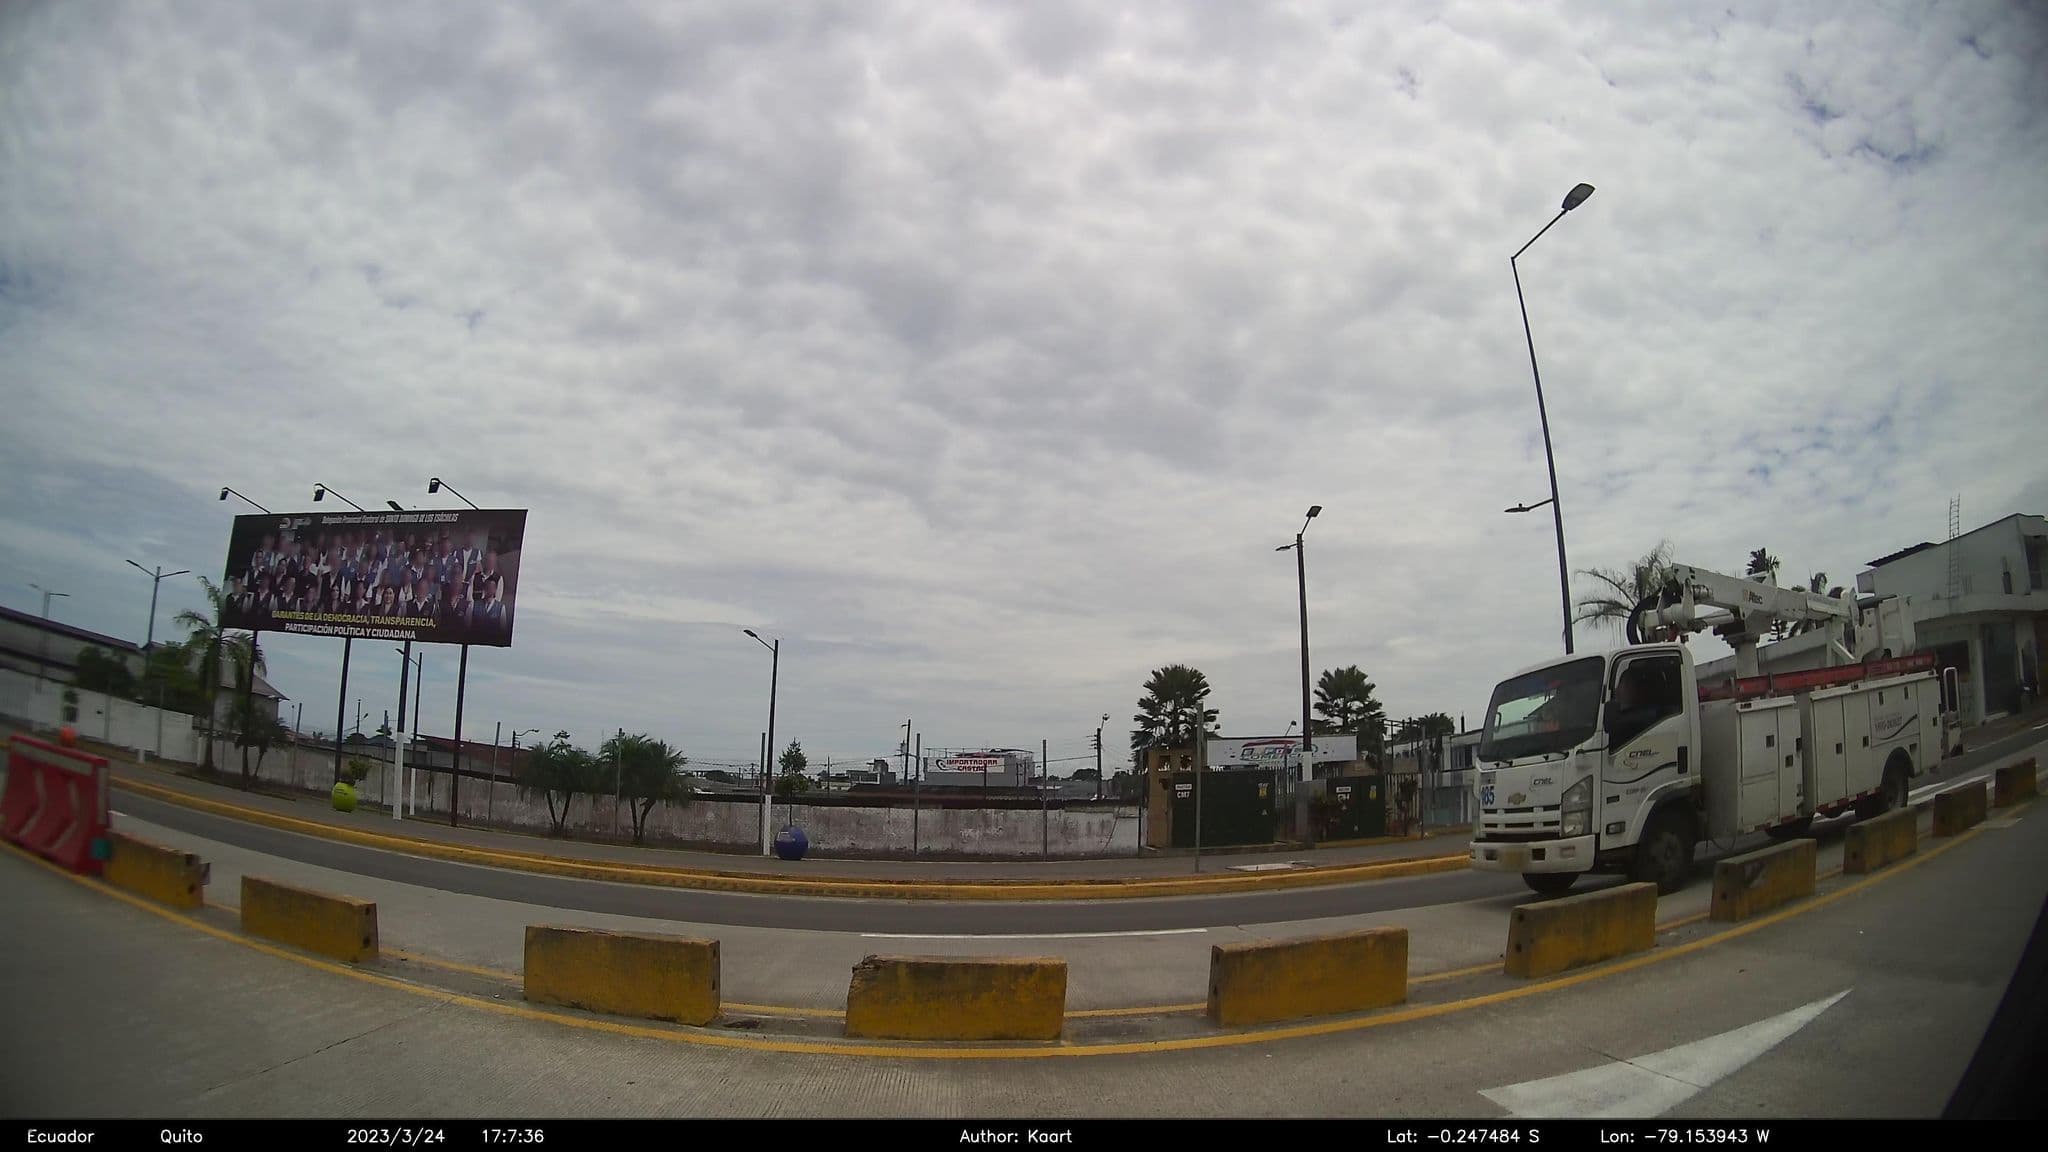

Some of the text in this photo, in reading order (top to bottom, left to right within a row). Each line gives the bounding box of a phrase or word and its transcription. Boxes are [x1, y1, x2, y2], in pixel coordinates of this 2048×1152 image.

[304, 612, 314, 620] DE
[314, 612, 323, 621] LA
[323, 613, 370, 625] DEMOCRACIA,
[371, 615, 436, 628] TRANSPARENCIA,
[285, 623, 333, 634] PARTICIPACIÓN
[334, 625, 366, 637] POLÍTICA
[372, 628, 416, 639] CIUDADANA
